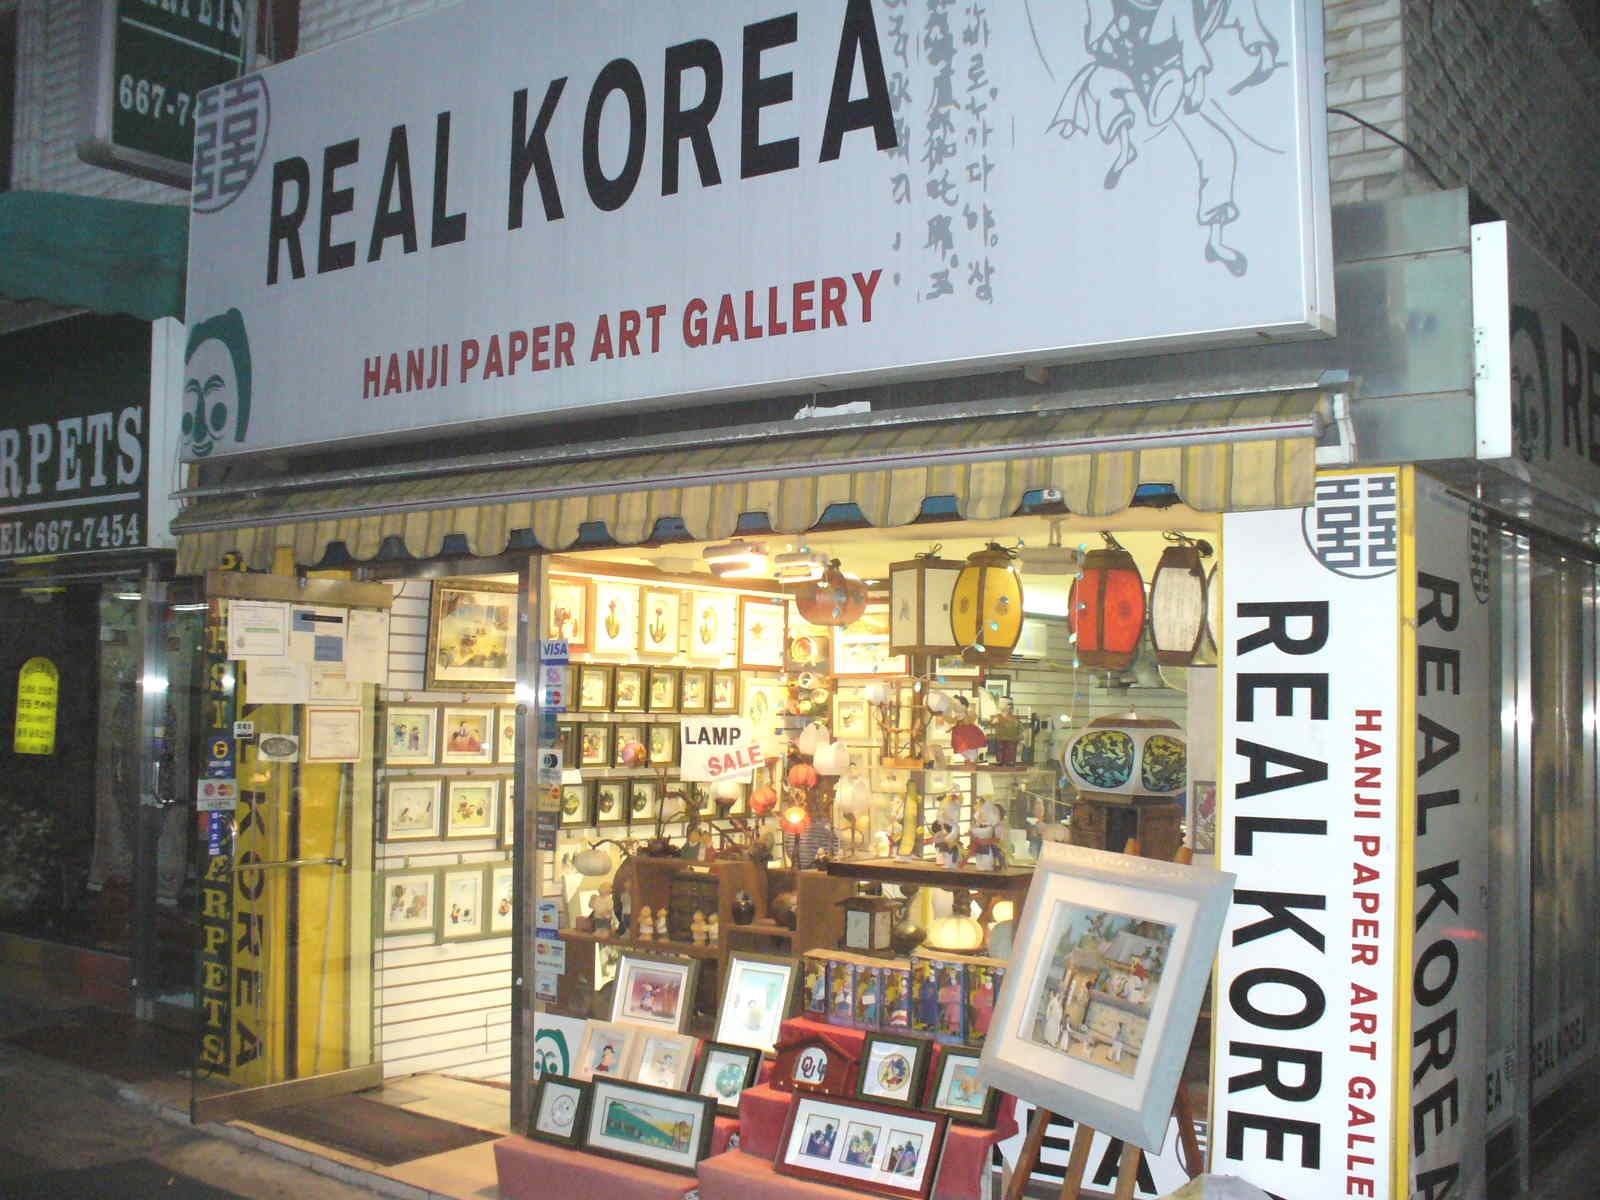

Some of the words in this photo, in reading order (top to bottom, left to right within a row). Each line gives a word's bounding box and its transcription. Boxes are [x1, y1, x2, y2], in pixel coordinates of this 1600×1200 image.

[119, 74, 198, 126] 667-7
[267, 111, 467, 285] REAL
[508, 0, 899, 230] KOREA
[362, 343, 449, 399] HANJI
[459, 321, 576, 384] PAPER
[590, 304, 667, 362] ART
[682, 268, 883, 348] GALLERY
[543, 643, 568, 656] VISA
[1416, 571, 1460, 836] REAL
[684, 725, 742, 746] LAMP
[707, 744, 763, 777] SALE
[1234, 600, 1330, 856] REAL
[1353, 709, 1383, 819] HANJI
[201, 854, 230, 1065] ARPETS
[236, 790, 267, 1067] KOREA
[1351, 834, 1381, 967] PAPER
[1225, 889, 1327, 1200] KORE
[1348, 982, 1379, 1061] ART
